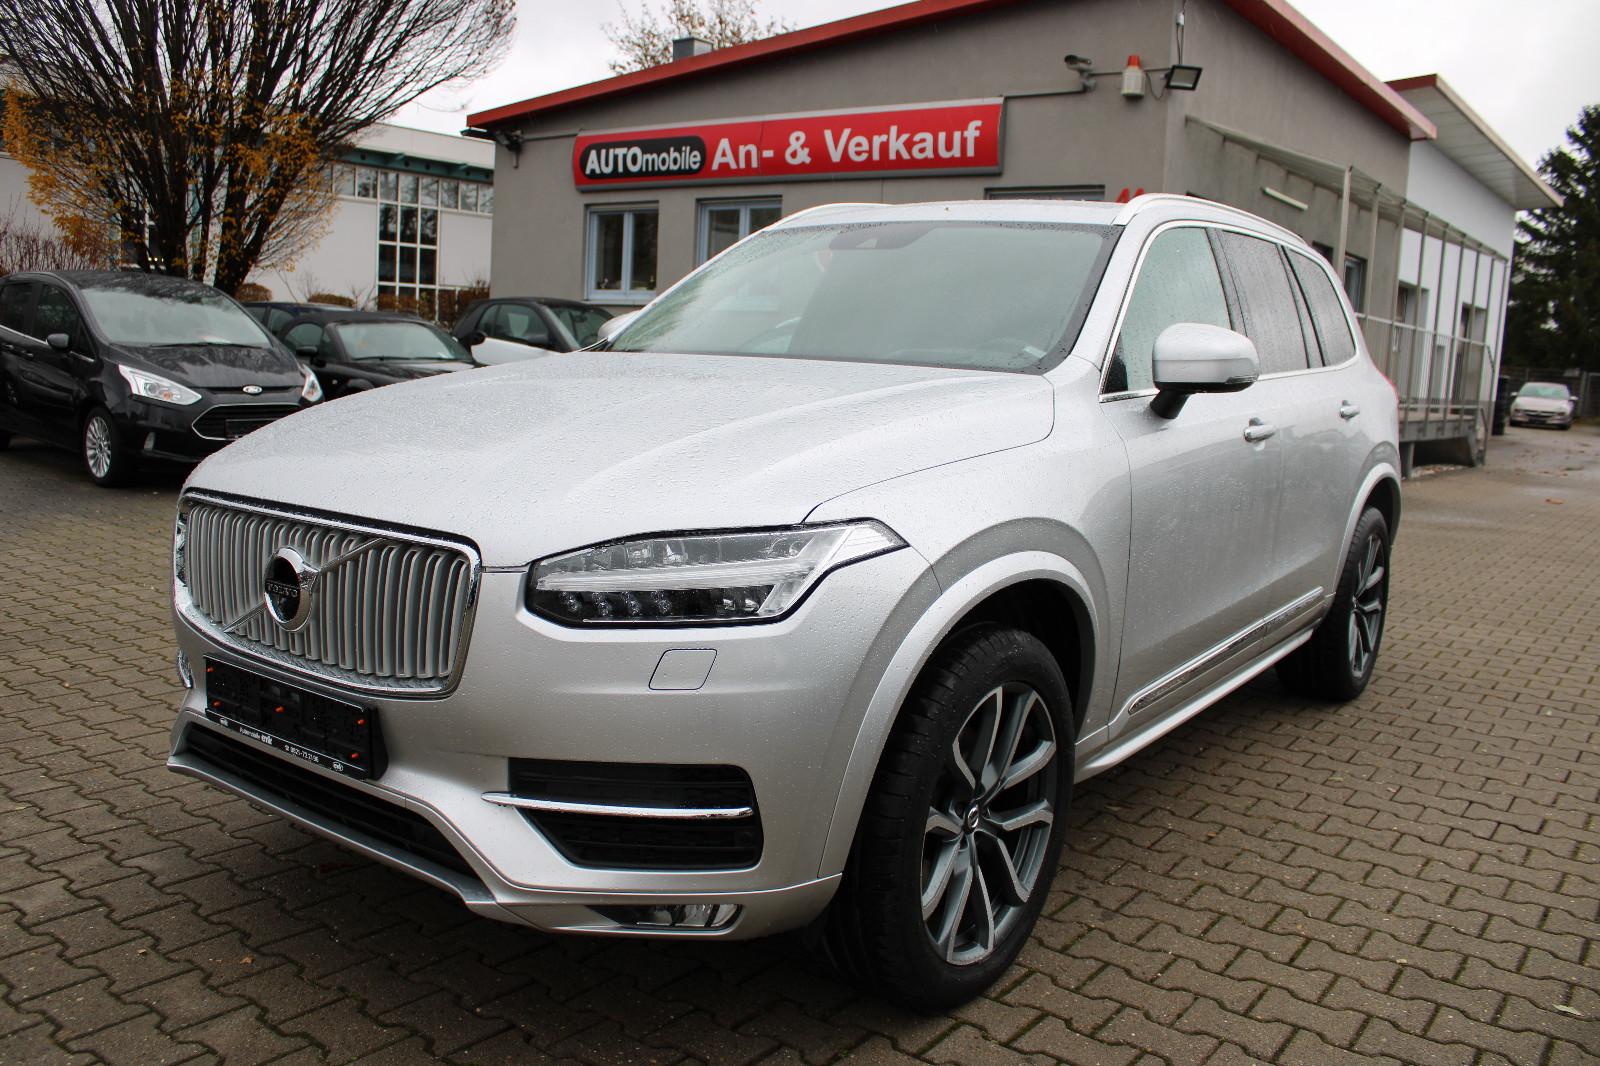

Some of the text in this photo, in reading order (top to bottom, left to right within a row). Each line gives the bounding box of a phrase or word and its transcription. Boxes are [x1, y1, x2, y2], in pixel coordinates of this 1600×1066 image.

[585, 120, 983, 175] AUTOmobile An- & Verkauf
